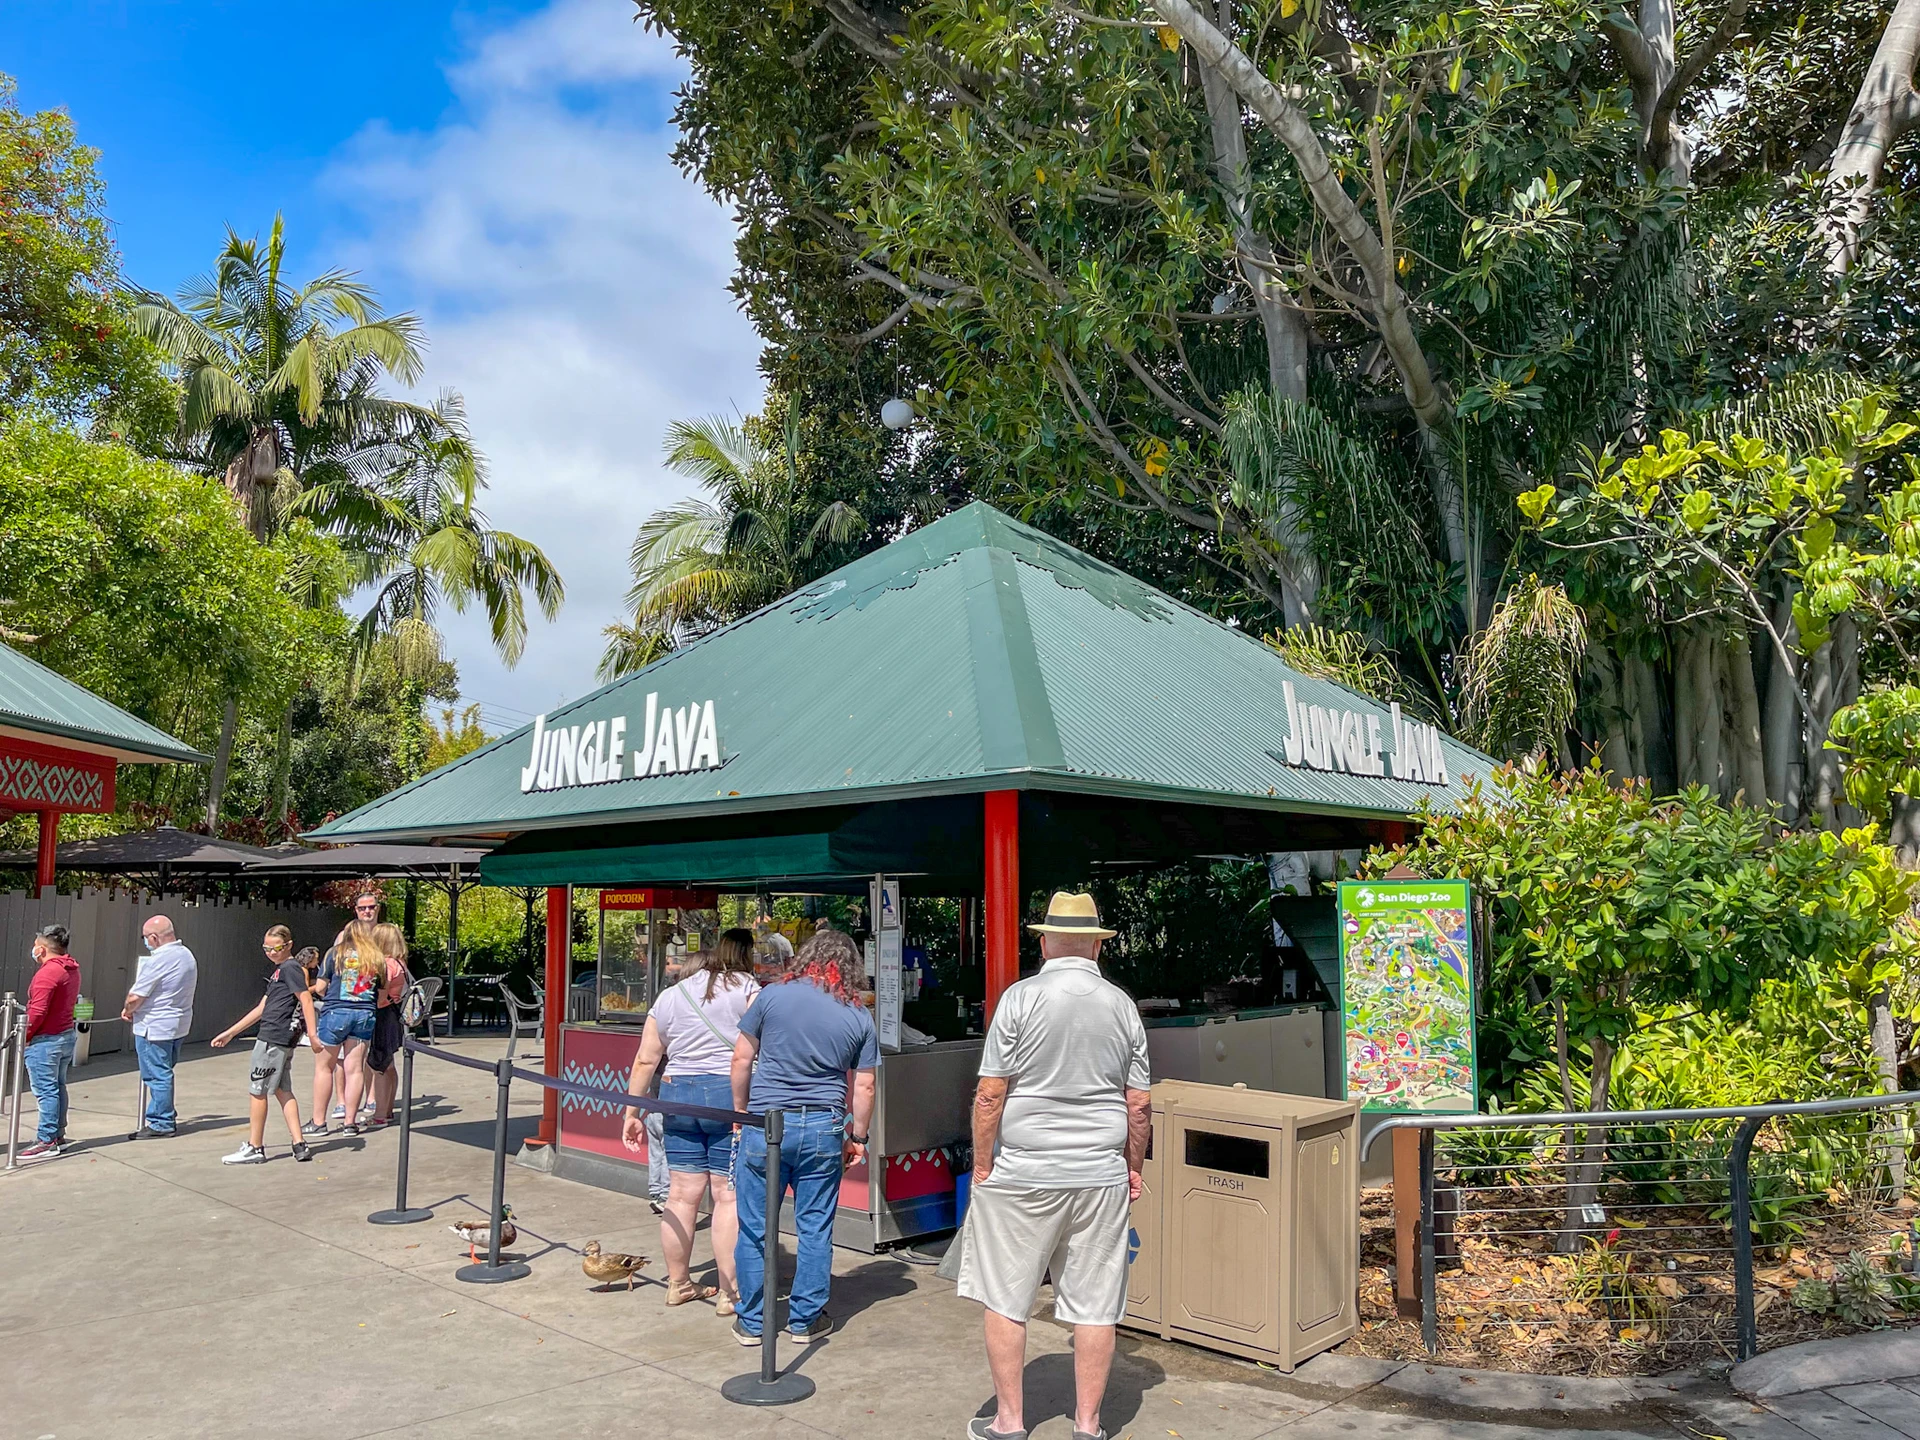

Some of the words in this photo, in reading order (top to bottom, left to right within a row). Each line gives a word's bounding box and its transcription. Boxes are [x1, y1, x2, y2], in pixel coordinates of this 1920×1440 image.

[1282, 680, 1384, 777] JUNGLE
[1390, 701, 1449, 786] JAVA
[520, 713, 627, 793] JUNGLE
[634, 691, 721, 778] JAVA
[605, 893, 645, 904] POPCORN
[1377, 893, 1398, 902] San
[1399, 892, 1429, 904] Diego
[1430, 892, 1451, 902] Zoo
[1206, 1175, 1244, 1191] TRASH
